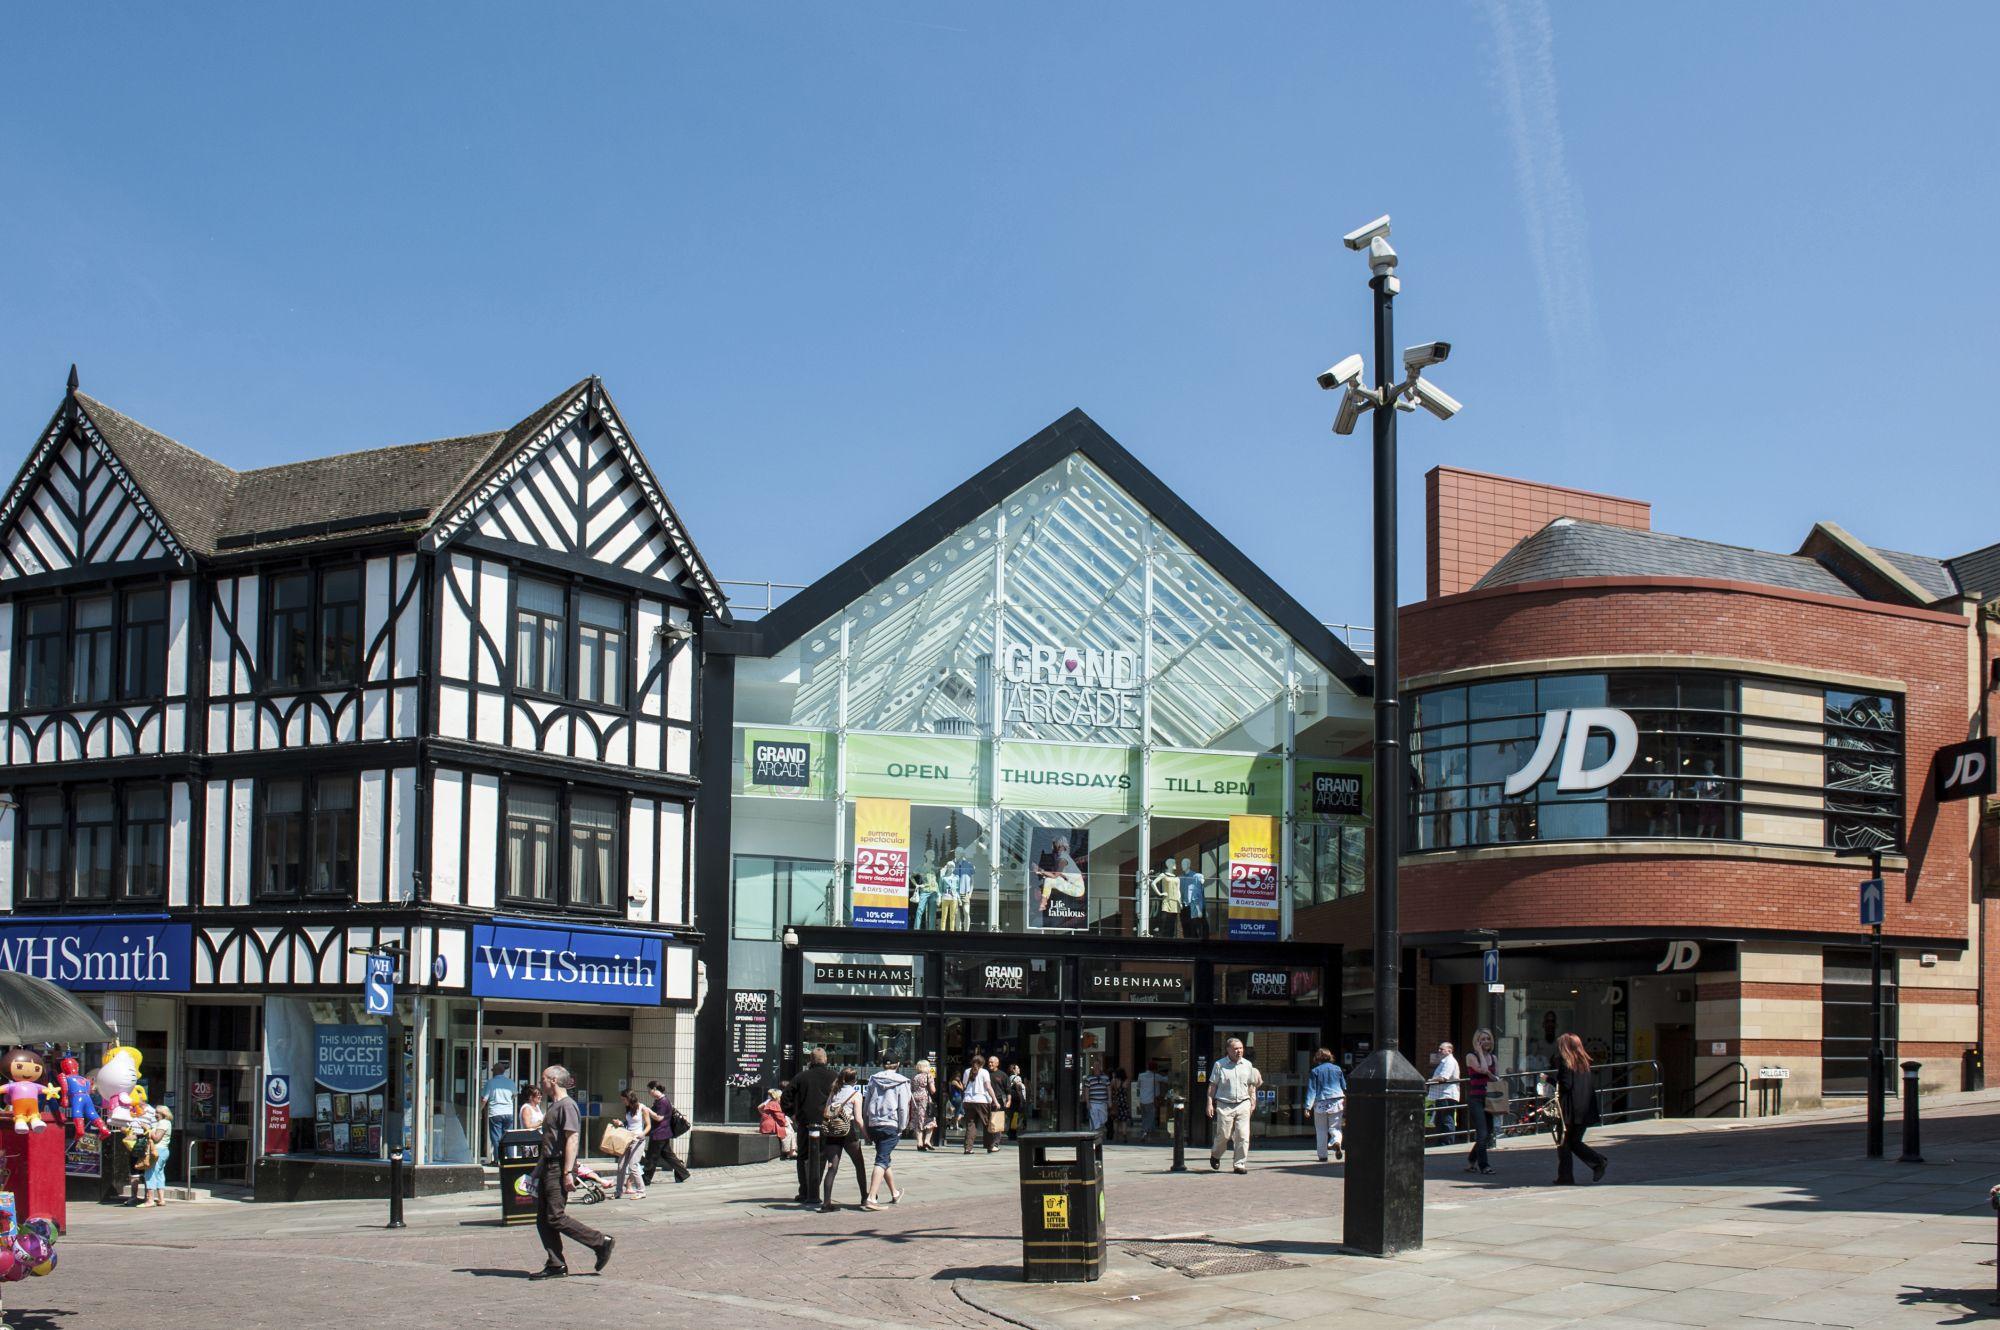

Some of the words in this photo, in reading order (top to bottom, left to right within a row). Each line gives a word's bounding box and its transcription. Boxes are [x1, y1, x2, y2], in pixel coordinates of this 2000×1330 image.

[1004, 642, 1138, 690] GRAND
[1004, 685, 1140, 728] ARCADE
[757, 746, 806, 764] GRAND
[1504, 708, 1638, 795] JD
[757, 762, 805, 778] ARCADE
[887, 763, 949, 780] OPEN
[1944, 752, 1986, 788] JD
[1001, 769, 1131, 790] THURSDAYS
[1164, 778, 1208, 794] TILL
[1213, 780, 1256, 796] 8PM
[1316, 777, 1359, 793] GRAND
[1316, 791, 1359, 806] ARCADE
[860, 836, 905, 844] spectacular
[858, 851, 905, 876] 25%
[889, 868, 905, 877] OFF
[1232, 866, 1275, 890] 25%
[1260, 882, 1276, 890] OFF
[1050, 899, 1066, 909] Life
[866, 911, 880, 919] 10%
[1048, 907, 1086, 918] fabulous
[0, 935, 170, 981] WHSmith
[1656, 940, 1701, 972] JD
[370, 959, 390, 972] WH
[480, 945, 655, 987] WHSmith
[984, 966, 1023, 978] GRAND
[816, 968, 911, 982] DEBENHAMS
[1093, 976, 1182, 988] DEBENHAMS
[1251, 972, 1287, 985] GRAND
[369, 970, 389, 1011] S
[984, 977, 1022, 989] ARCADE
[1251, 984, 1287, 995] ARCADE
[735, 992, 767, 1003] GRAND
[735, 1001, 767, 1012] ARCADE
[320, 1035, 339, 1045] THIS
[342, 1035, 384, 1045] MONTH'S
[319, 1047, 384, 1062] BIGGEST
[319, 1064, 345, 1076] NEW
[348, 1065, 383, 1077] TITLES
